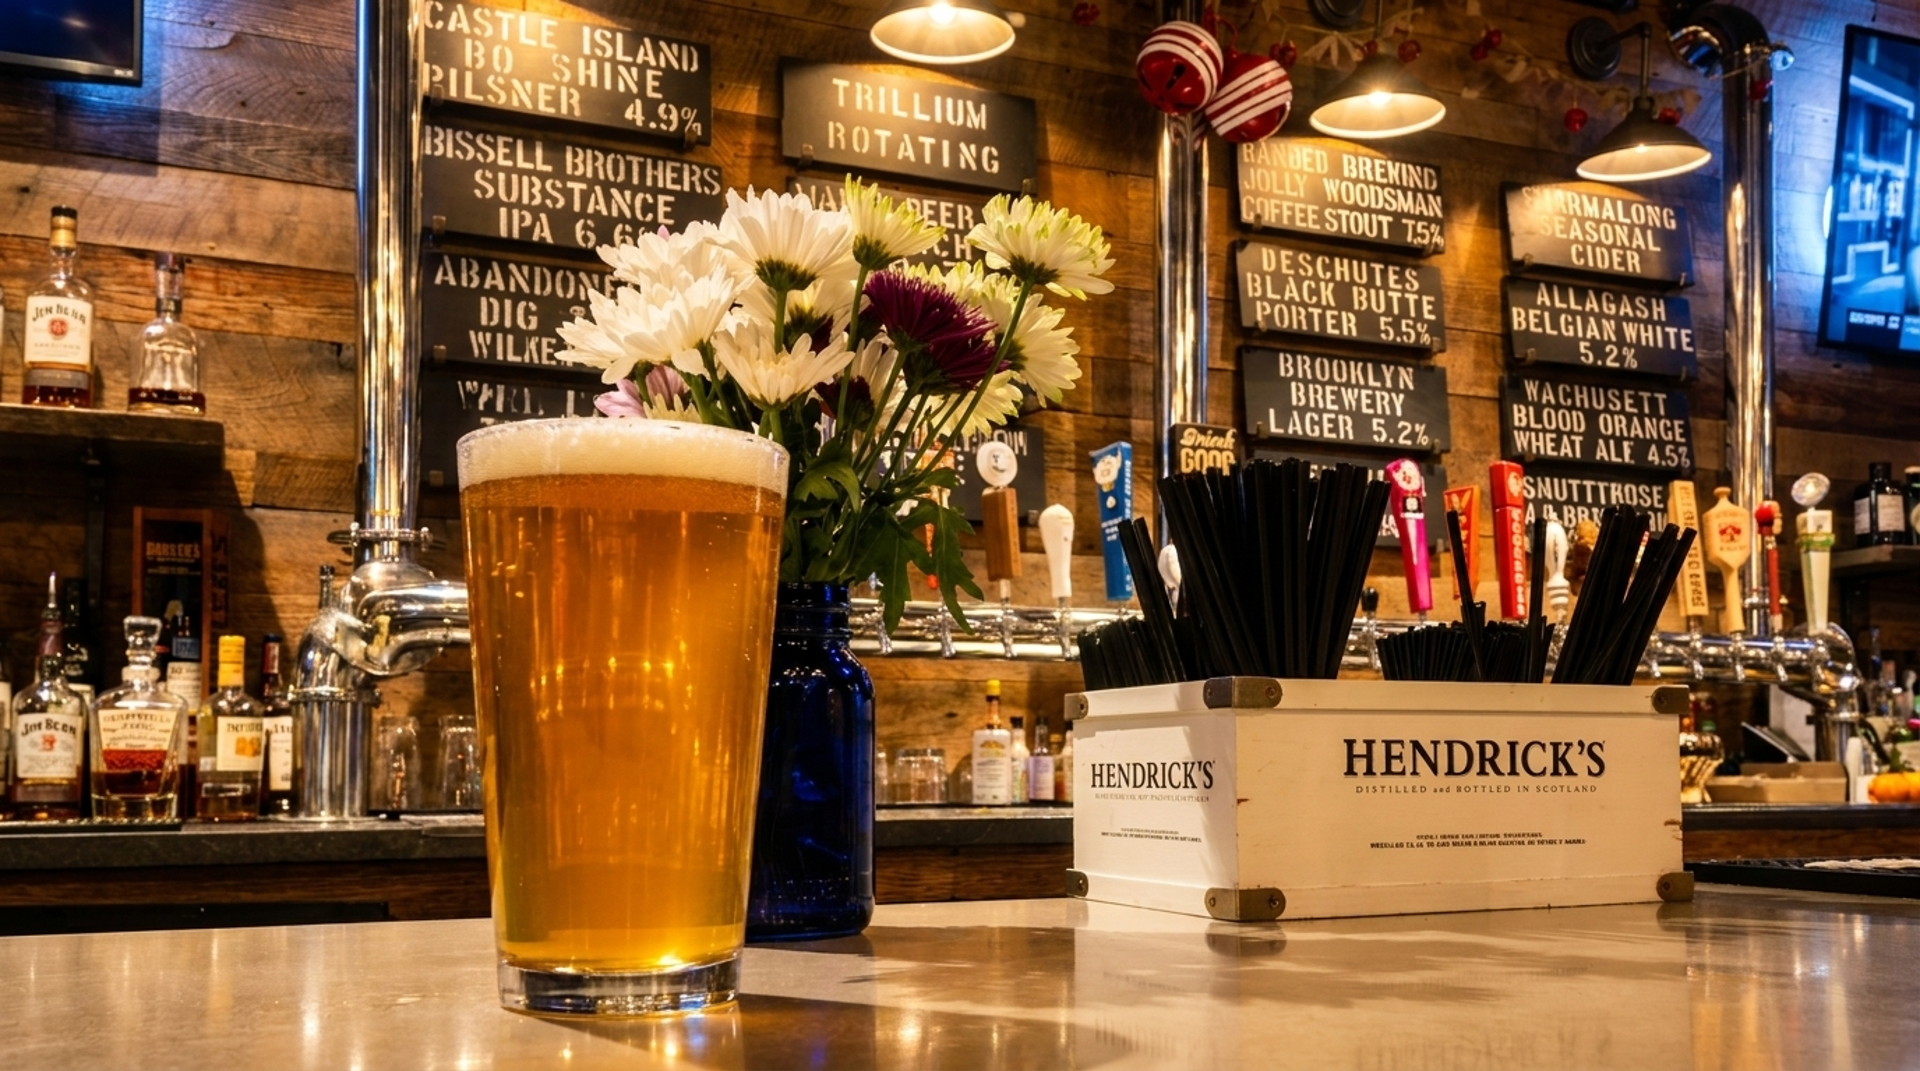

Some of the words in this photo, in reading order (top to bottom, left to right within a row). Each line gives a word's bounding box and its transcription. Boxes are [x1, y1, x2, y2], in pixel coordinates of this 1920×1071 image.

[424, 0, 559, 49] CASTLE
[582, 25, 699, 73] ISLAND
[464, 38, 514, 75] BO
[552, 53, 664, 99] SHINE
[423, 62, 582, 117] PILSNER
[624, 98, 702, 137] 4.9%
[832, 77, 987, 131] TRILLIUM
[423, 125, 553, 172] BISSELL
[565, 145, 721, 196] BROTHERS
[828, 120, 1000, 175] ROTATING
[473, 168, 676, 225] SUBSTANCE
[1242, 168, 1308, 198] JOLLY
[1322, 177, 1444, 218] WOODSMAN
[498, 206, 555, 245] IPA
[1241, 195, 1321, 230] COFFEE
[1324, 207, 1393, 240] STOUT
[1539, 215, 1662, 252] SEASONAL
[434, 254, 633, 301] ABANDONE
[1261, 247, 1420, 292] DESCHUTES
[1570, 243, 1642, 274] CIDER
[479, 296, 539, 331] DIG
[1246, 272, 1336, 307] BLACK
[1352, 285, 1437, 320] BUTTE
[1536, 282, 1667, 322] ALLAGASH
[1255, 300, 1358, 337] PORTER
[1379, 316, 1431, 345] 5.5%
[1511, 306, 1617, 343] BELGIAN
[1622, 321, 1695, 353] WHITE
[1278, 352, 1415, 391] BROOKLYN
[1578, 340, 1638, 369] 5.2%
[1290, 381, 1405, 417] BREWERY
[1524, 378, 1667, 417] WACHUSETT
[1268, 407, 1355, 440] LAGER
[1371, 417, 1429, 446] 5.2%
[1512, 403, 1586, 434] BLOOD
[1599, 412, 1687, 443] ORANGE
[1513, 430, 1584, 459] WHEAT
[1090, 760, 1214, 790] HENDRICK'S
[1342, 738, 1606, 778] HENDRICK'S
[1355, 784, 1428, 794] DISTILLED
[1432, 785, 1451, 794] and
[1455, 784, 1512, 794] BOTTLED
[1516, 784, 1530, 794] IN
[1535, 784, 1598, 793] SCOTLAND
